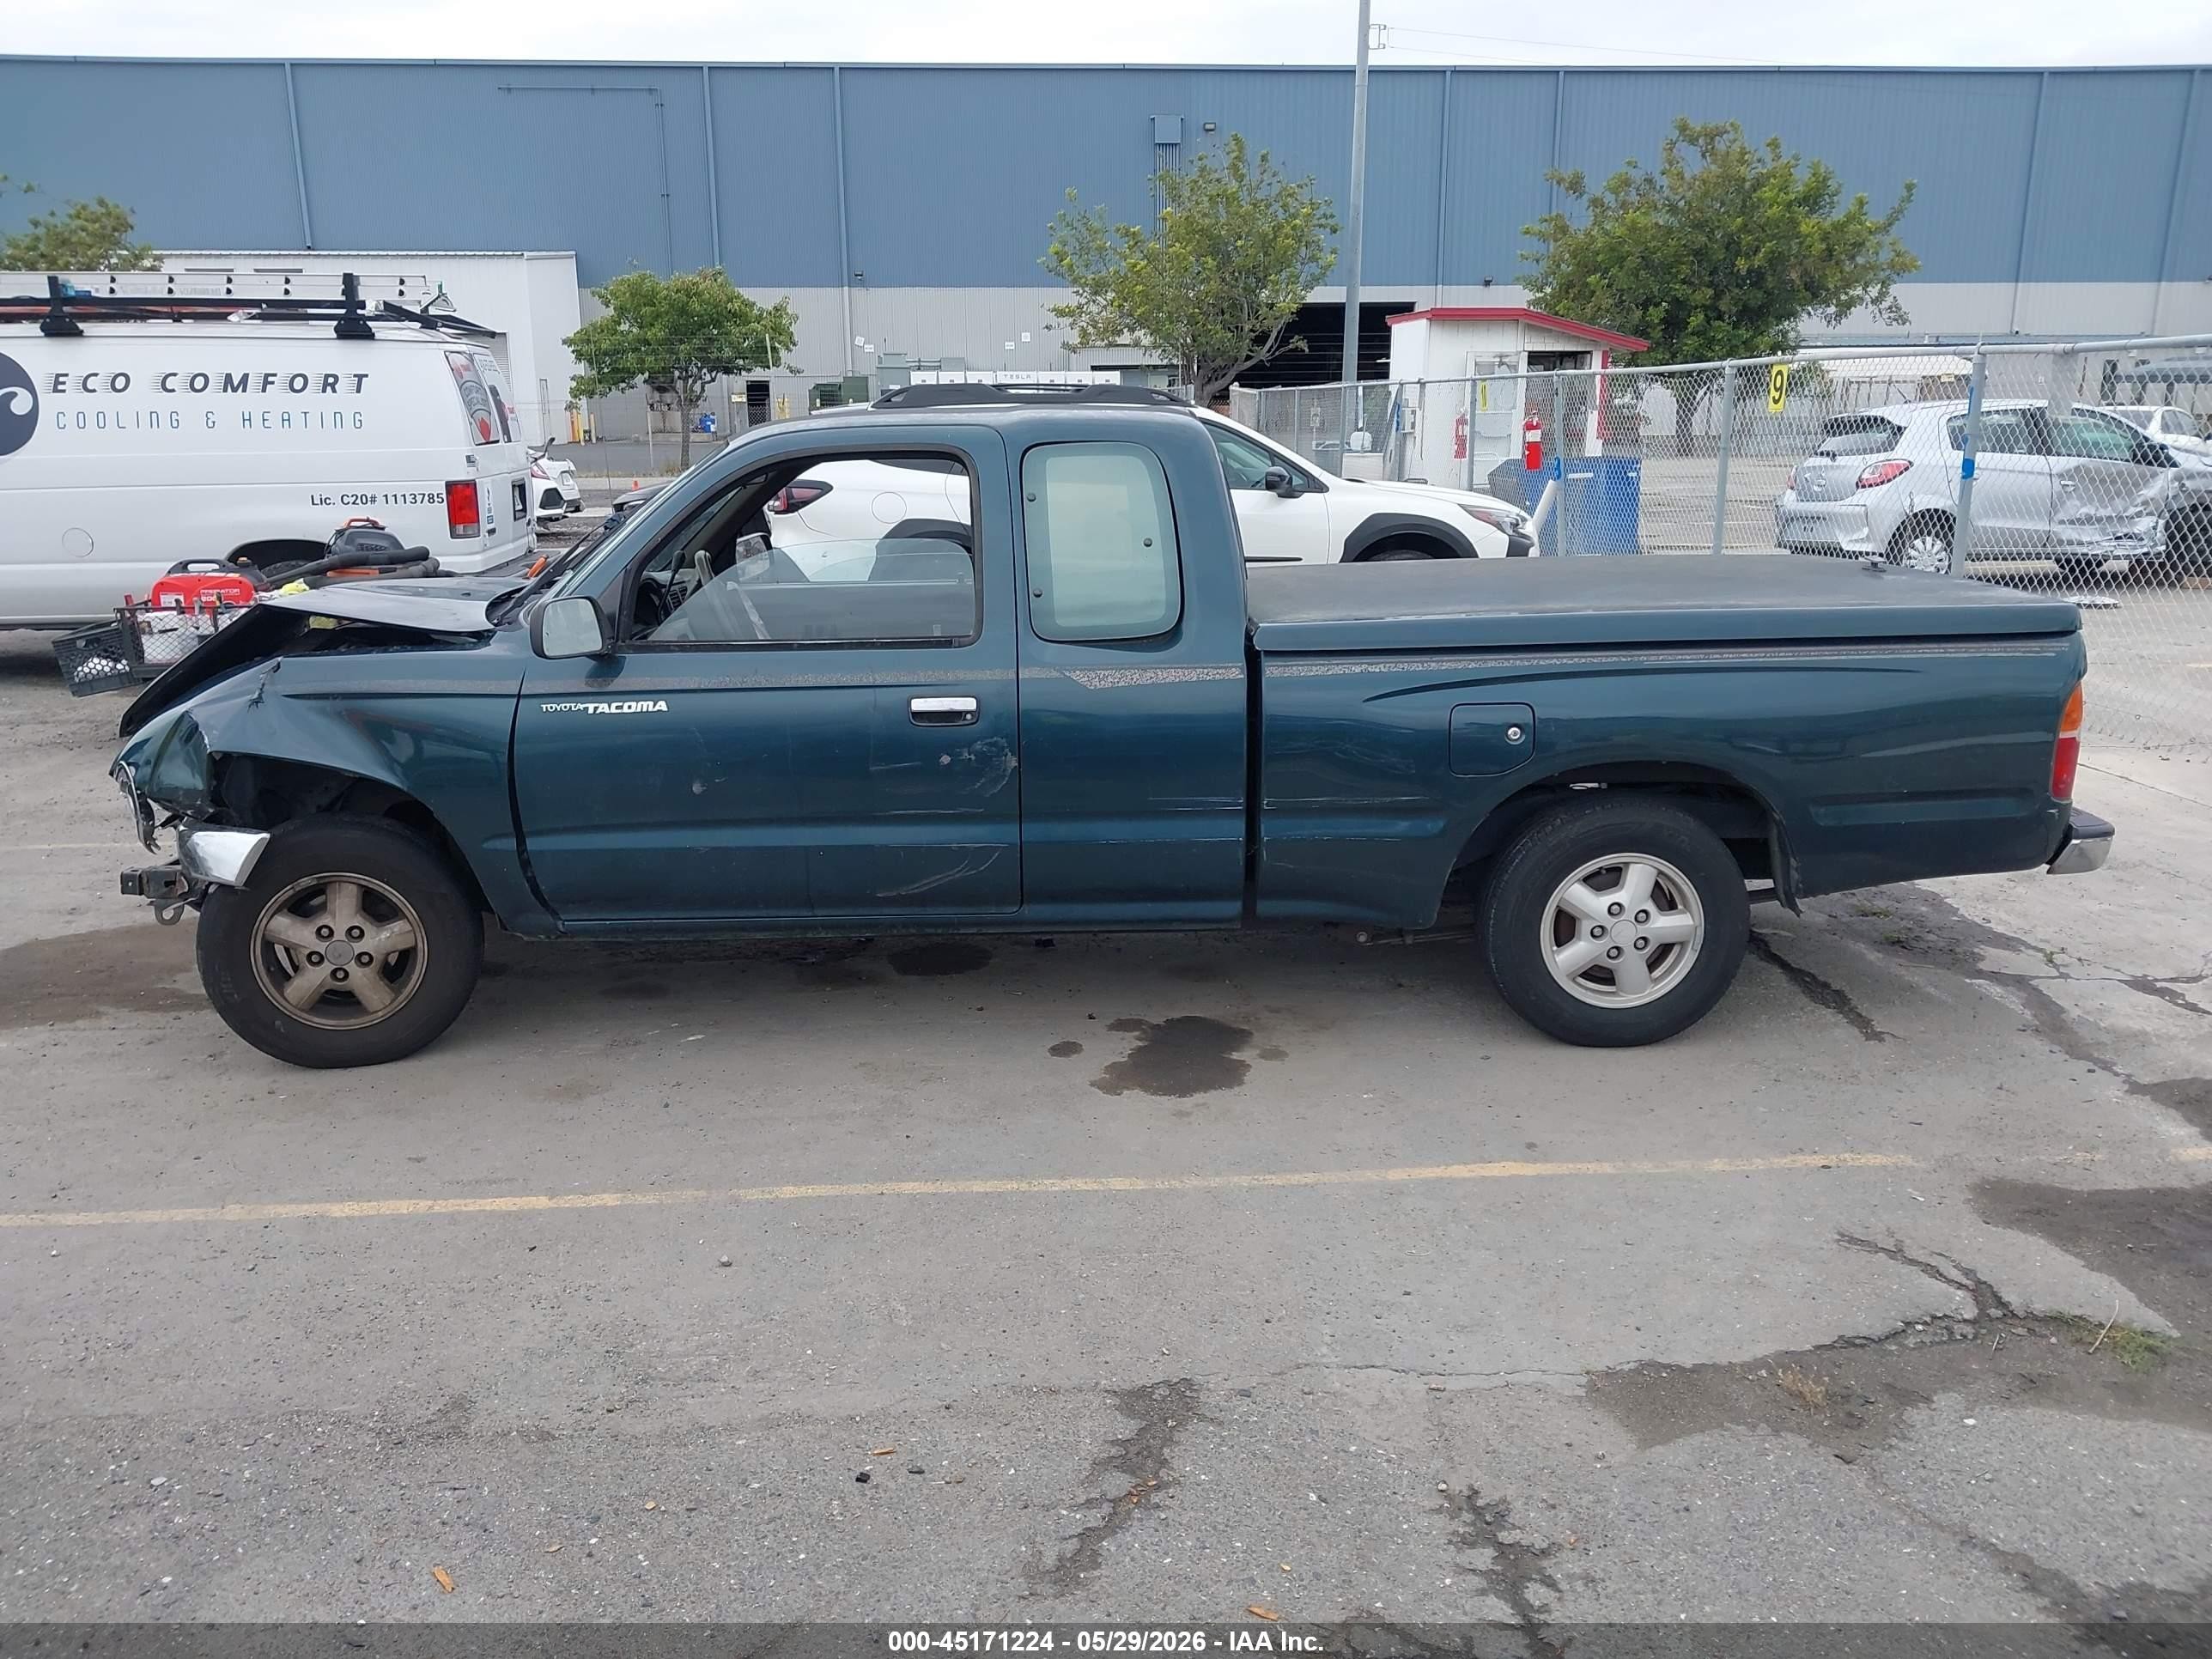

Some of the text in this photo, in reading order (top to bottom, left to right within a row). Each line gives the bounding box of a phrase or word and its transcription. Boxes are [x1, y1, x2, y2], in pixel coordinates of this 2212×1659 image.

[44, 372, 369, 393] ECO COMFORT
[1771, 369, 1784, 405] 9
[56, 410, 362, 429] COOLING & HEATING
[310, 493, 445, 506] Lic. C20# 1113785
[540, 701, 668, 714] TOYOTA TACOMA
